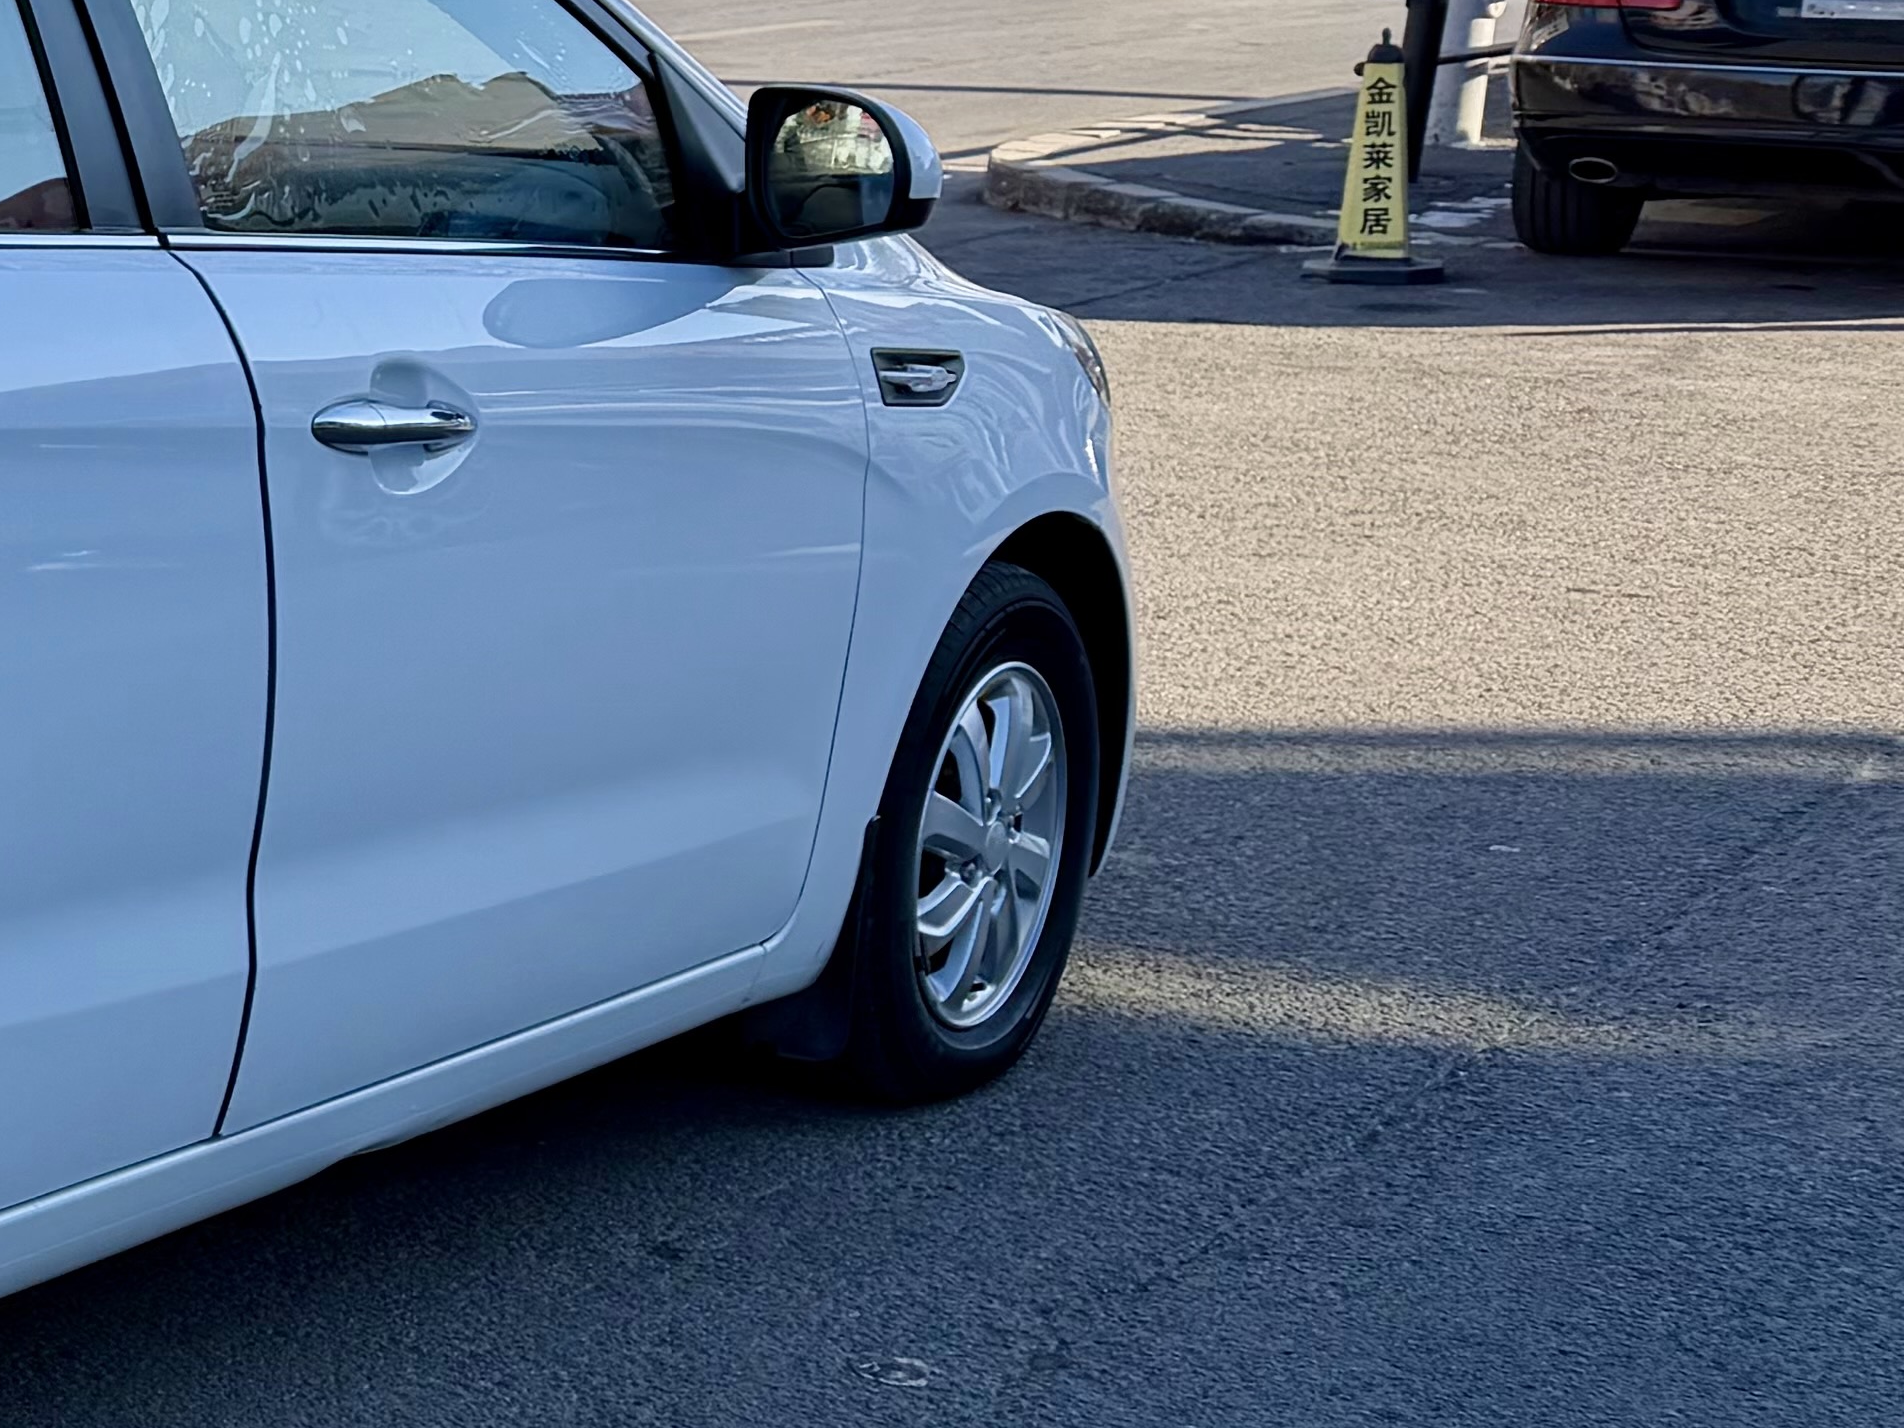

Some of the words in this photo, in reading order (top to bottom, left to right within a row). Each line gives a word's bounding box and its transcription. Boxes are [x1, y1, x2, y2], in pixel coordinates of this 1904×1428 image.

[1359, 77, 1399, 236] 金凯莱家居
